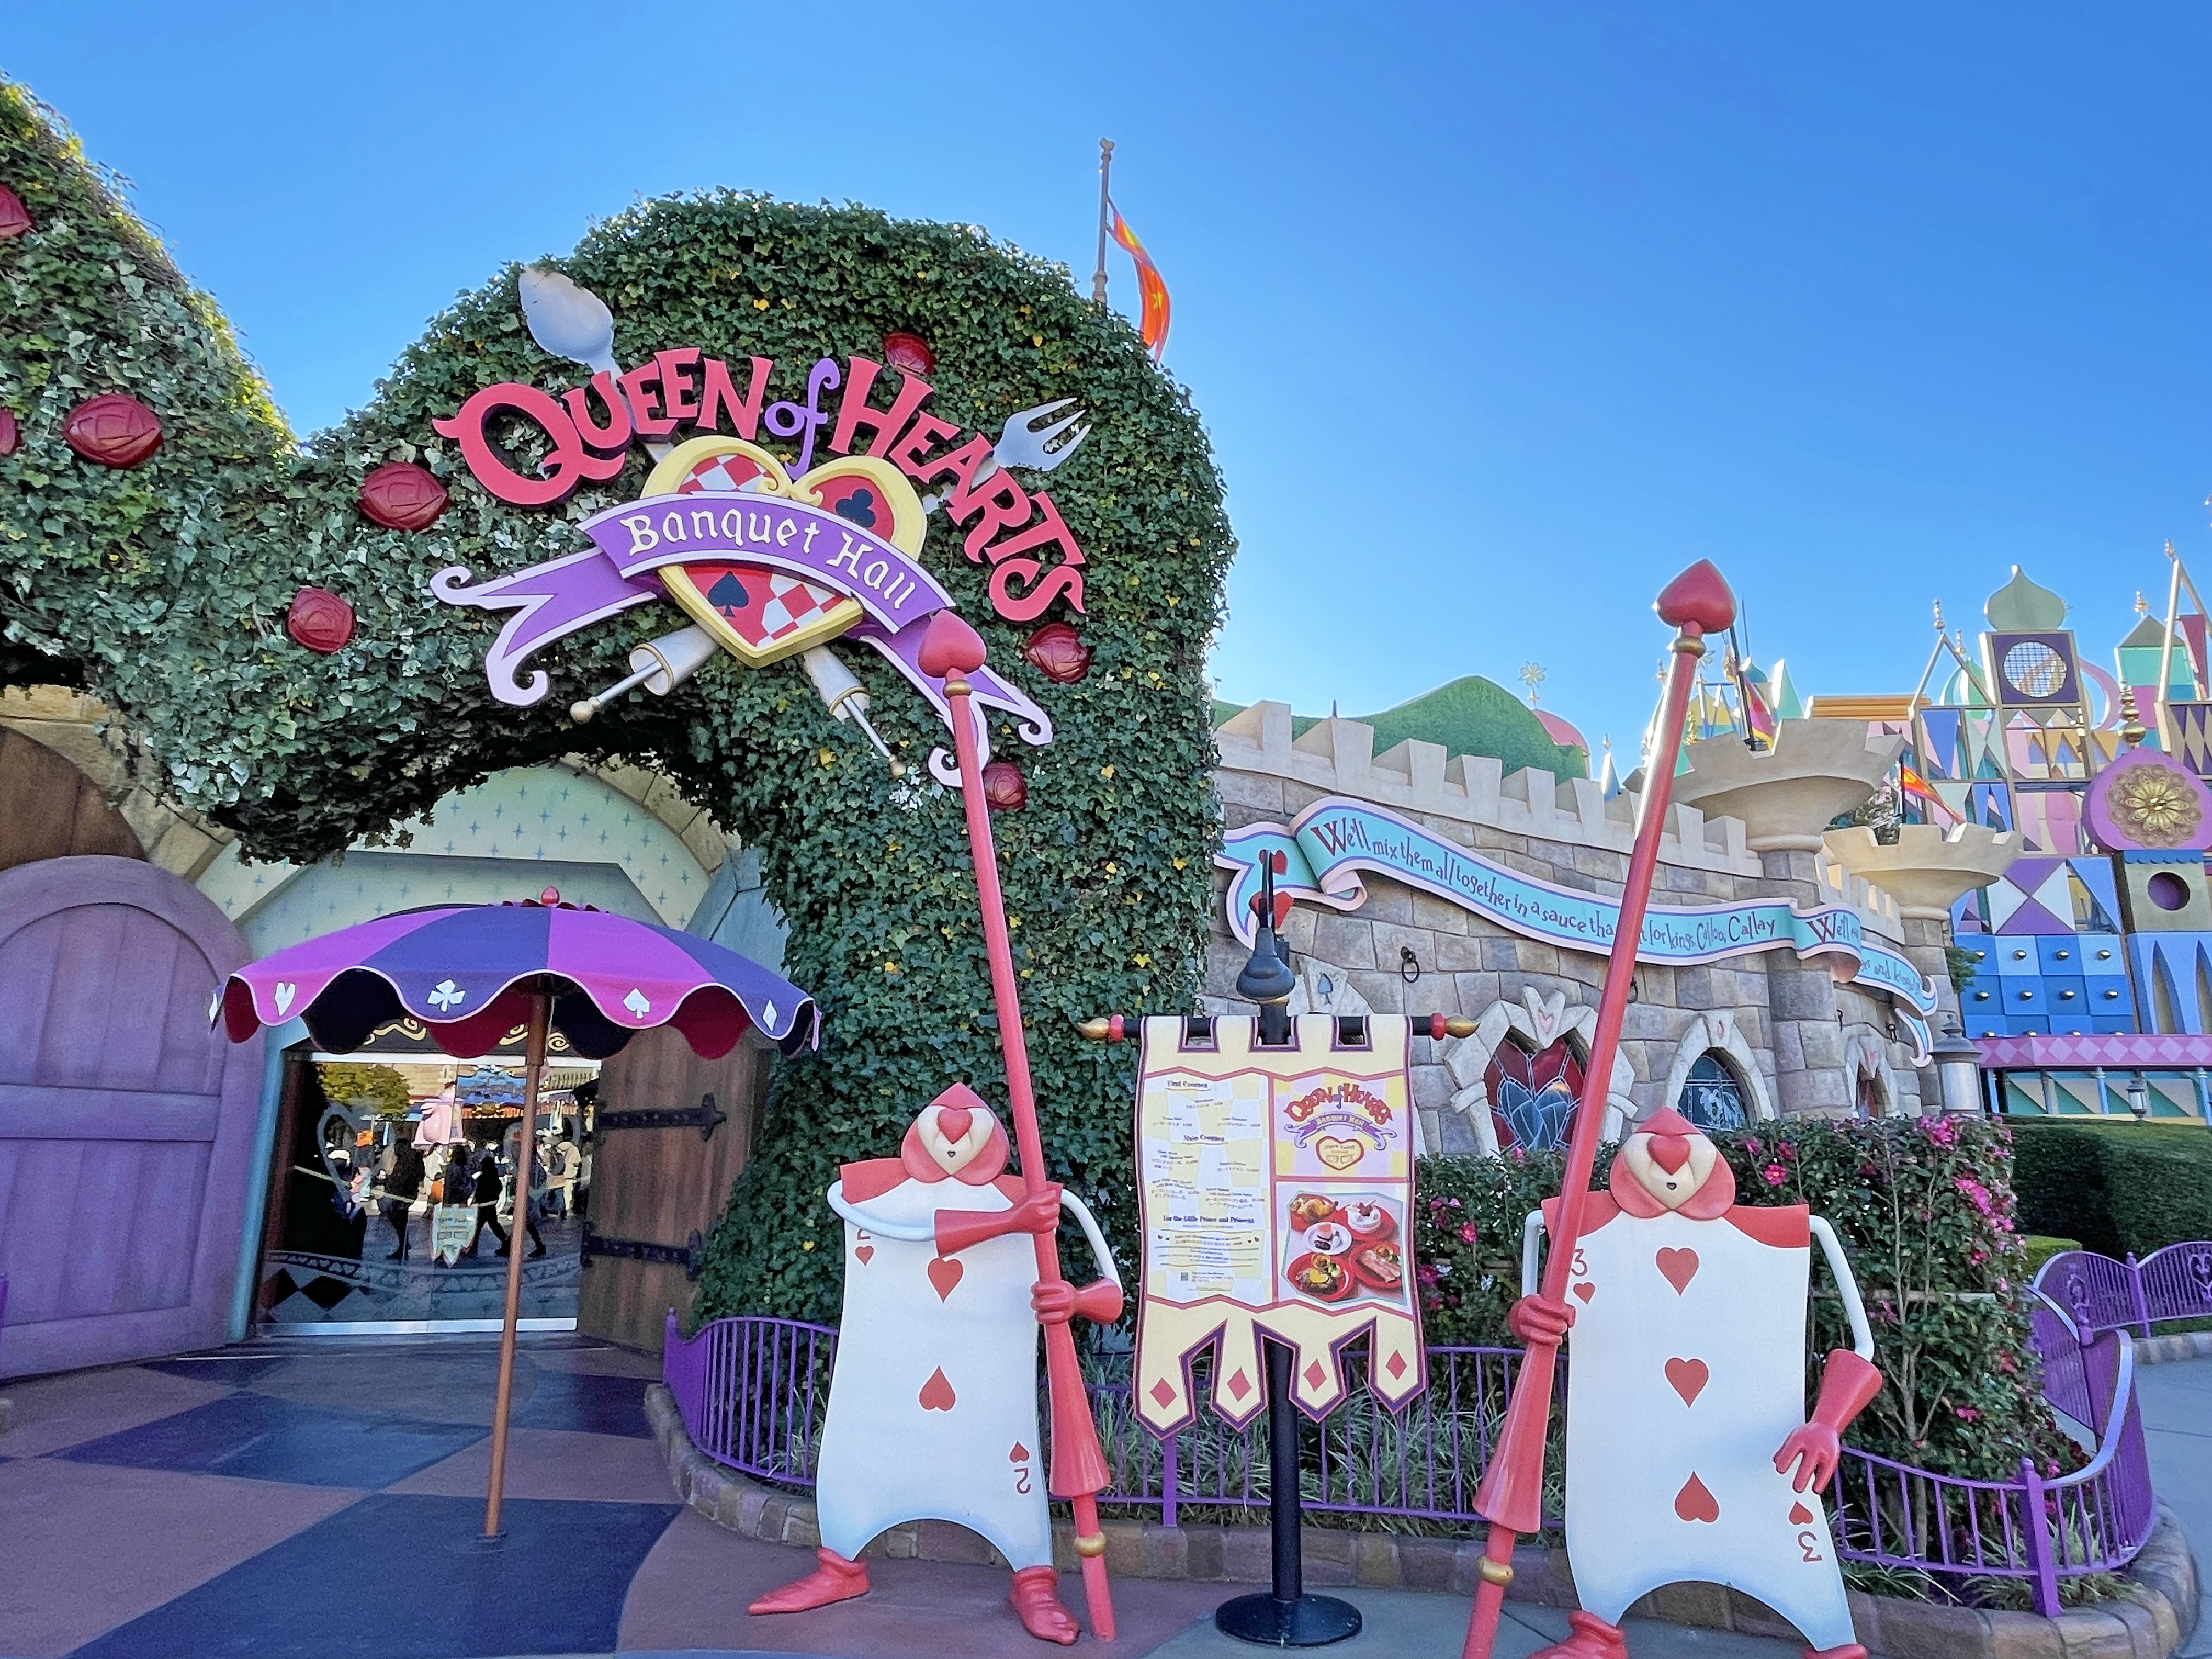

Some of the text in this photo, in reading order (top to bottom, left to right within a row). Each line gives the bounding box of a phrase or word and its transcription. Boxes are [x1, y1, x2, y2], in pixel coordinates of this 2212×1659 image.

[432, 347, 1086, 622] QUEEN of HEARTS
[620, 509, 916, 610] Banquet Hall
[1372, 838, 1398, 860] mix
[1401, 836, 1434, 872] them
[1435, 851, 1455, 885] all
[1456, 865, 1511, 911] together
[1514, 893, 1527, 918] in
[1531, 901, 1541, 916] a
[1541, 910, 1587, 933] sauce
[1649, 919, 1666, 946] for
